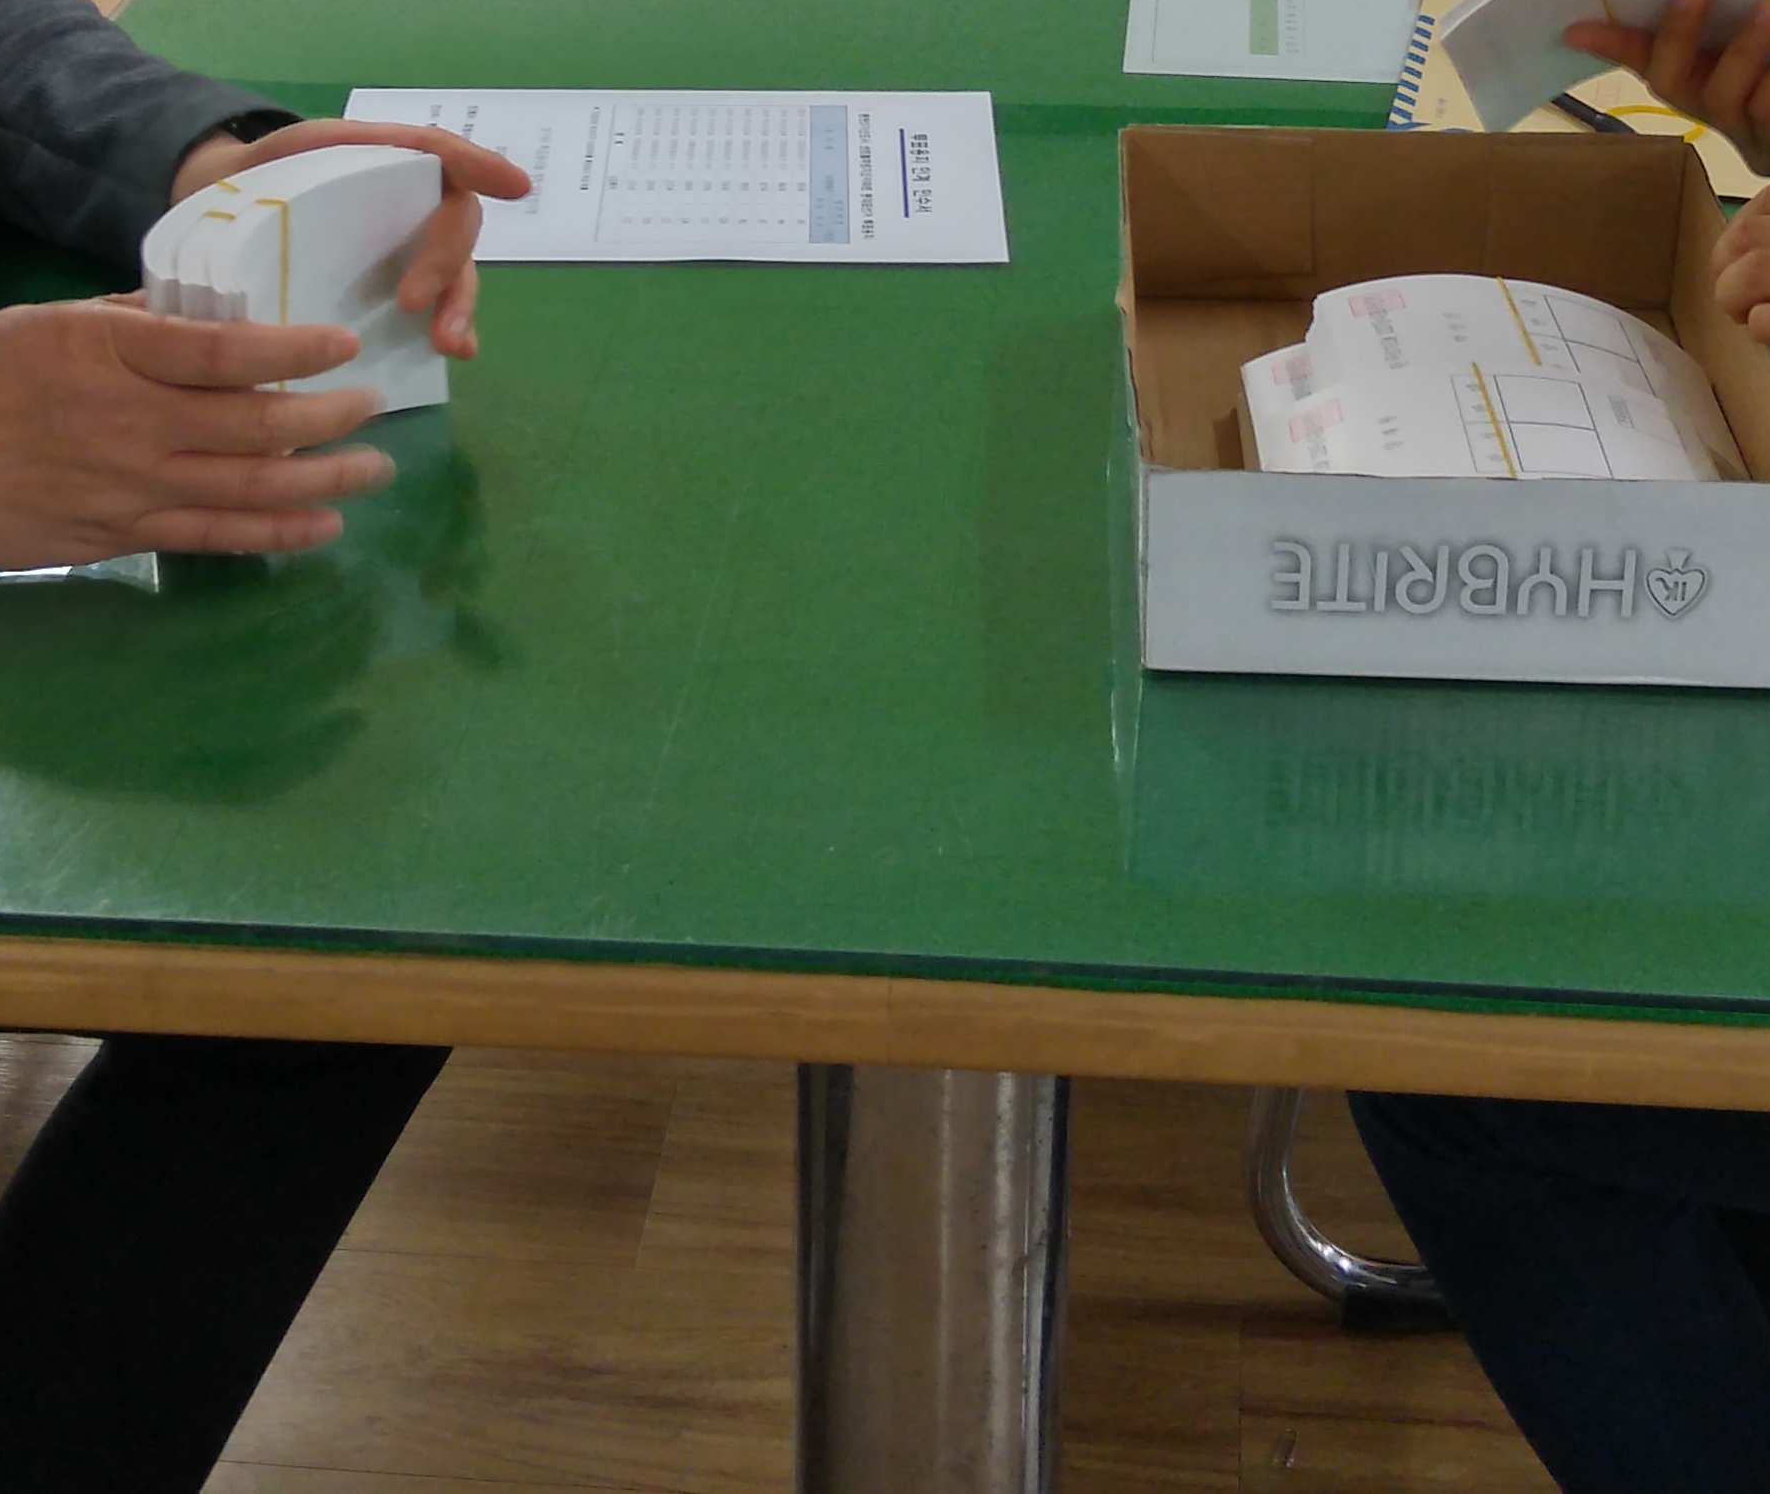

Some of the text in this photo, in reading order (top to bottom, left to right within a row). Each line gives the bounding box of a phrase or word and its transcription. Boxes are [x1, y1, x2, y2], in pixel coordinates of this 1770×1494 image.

[909, 133, 933, 213] 투표용지 인계 인수서
[1271, 541, 1638, 619] HYBRITE
